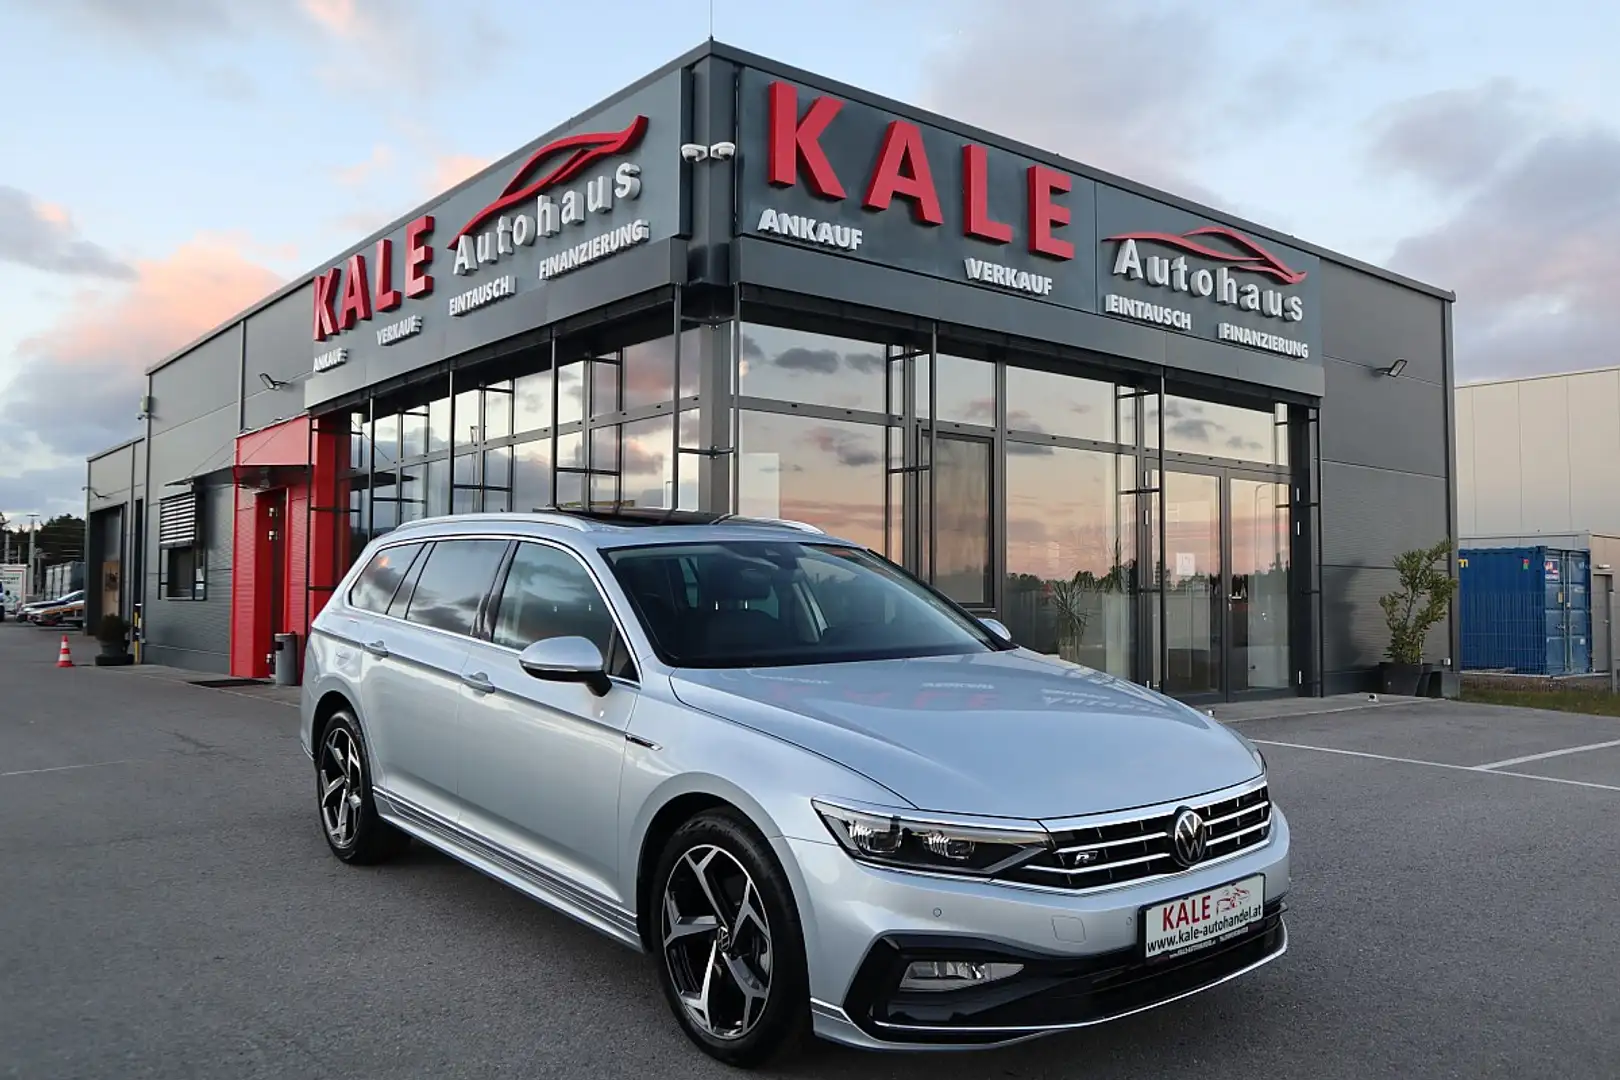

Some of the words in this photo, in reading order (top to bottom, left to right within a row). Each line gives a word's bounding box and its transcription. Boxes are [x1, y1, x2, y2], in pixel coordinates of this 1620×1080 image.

[769, 82, 1074, 259] KALE
[453, 162, 641, 275] Autohaus
[758, 209, 862, 251] ANKAUF
[538, 219, 650, 281] FINANZIERUNG
[313, 215, 435, 342] KALE
[449, 276, 515, 317] EINTAUSCH
[965, 258, 1052, 296] VERKAUF
[1114, 239, 1303, 322] Autohaus
[376, 314, 423, 346] VERKAUF
[1106, 295, 1191, 330] EINTAUSCH
[313, 348, 347, 372] ANKAUF
[1219, 323, 1308, 358] FINANZIERUNG
[1147, 905, 1262, 953] www.kale-autohandel.at
[1162, 896, 1211, 931] KALE
